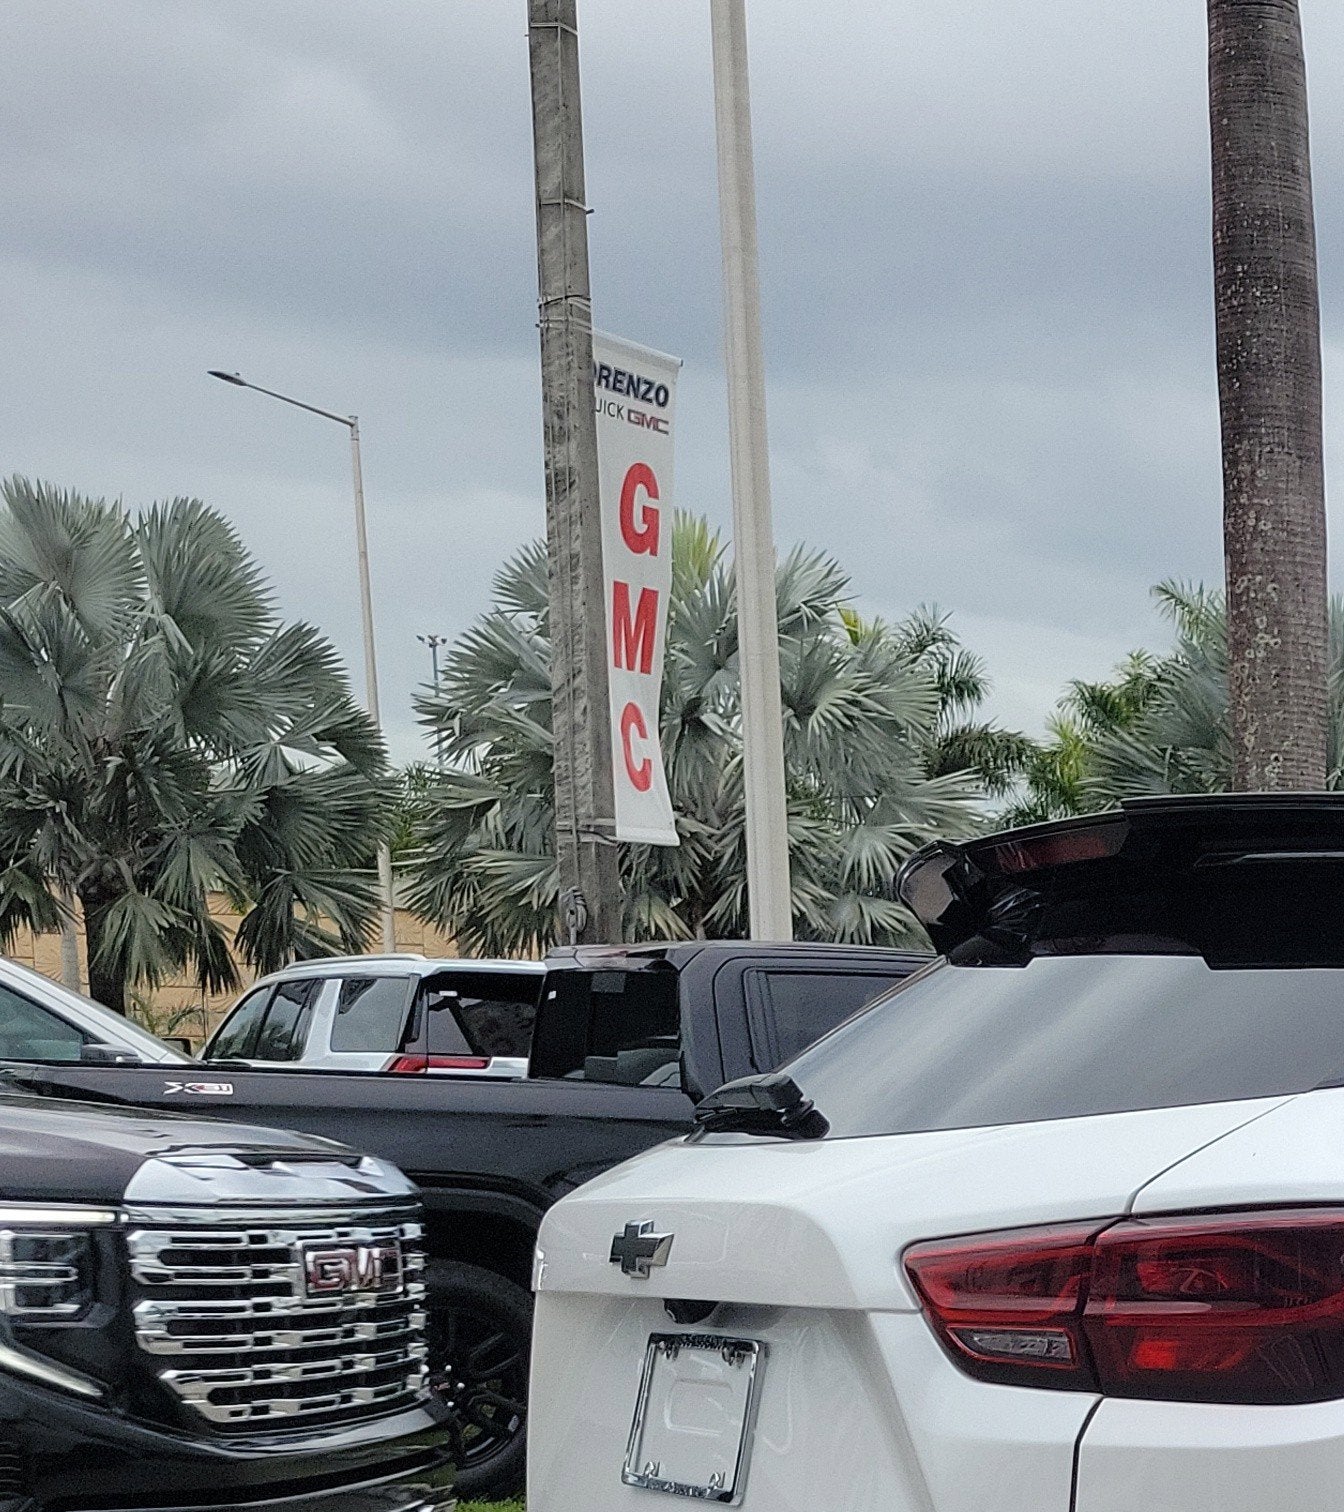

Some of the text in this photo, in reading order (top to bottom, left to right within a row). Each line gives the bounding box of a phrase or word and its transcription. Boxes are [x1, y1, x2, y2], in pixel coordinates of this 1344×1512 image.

[593, 361, 669, 408] RENZO
[627, 409, 670, 436] GMC
[613, 463, 660, 792] GMC
